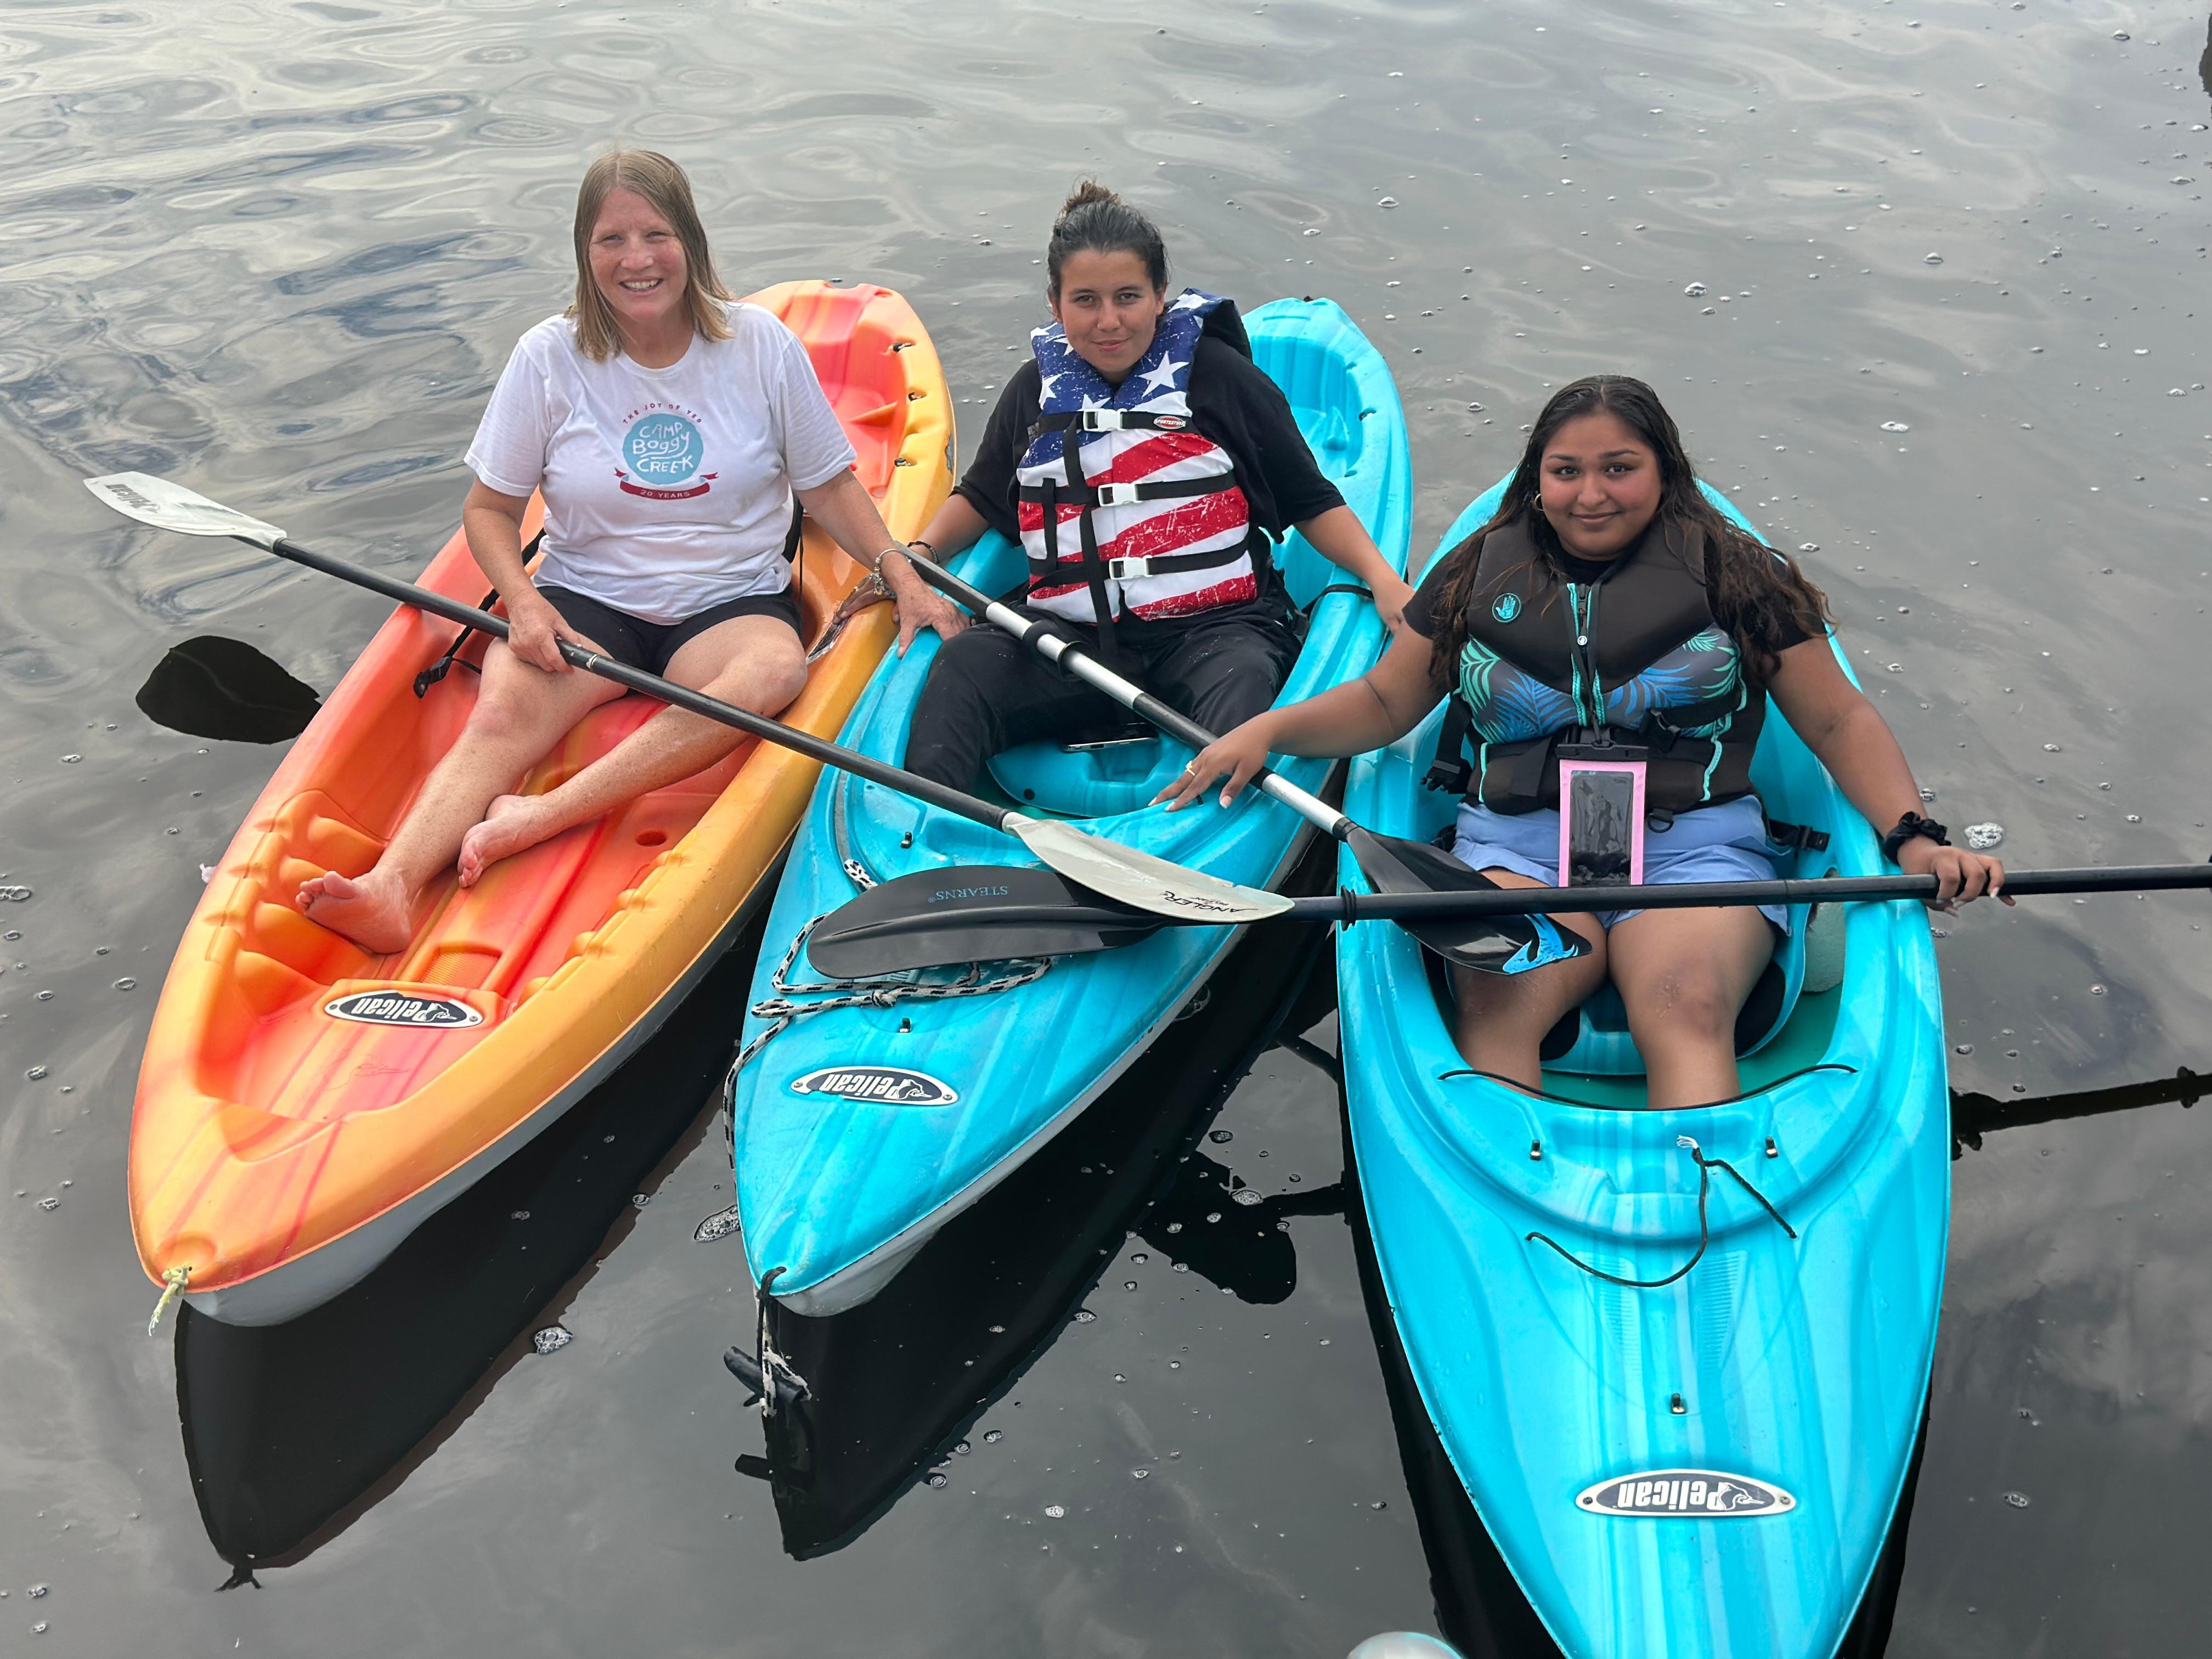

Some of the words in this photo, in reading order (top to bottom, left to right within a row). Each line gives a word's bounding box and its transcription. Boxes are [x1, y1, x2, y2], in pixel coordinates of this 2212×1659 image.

[623, 410, 639, 424] THE
[686, 410, 702, 423] YES
[639, 422, 683, 439] CAMP
[633, 431, 690, 459] Boggy
[636, 455, 694, 473] CREEK
[1165, 890, 1259, 913] ANGLER
[351, 998, 439, 1022] Pelican
[819, 1074, 912, 1100] Pelican
[1617, 1480, 1731, 1510] Pelican
